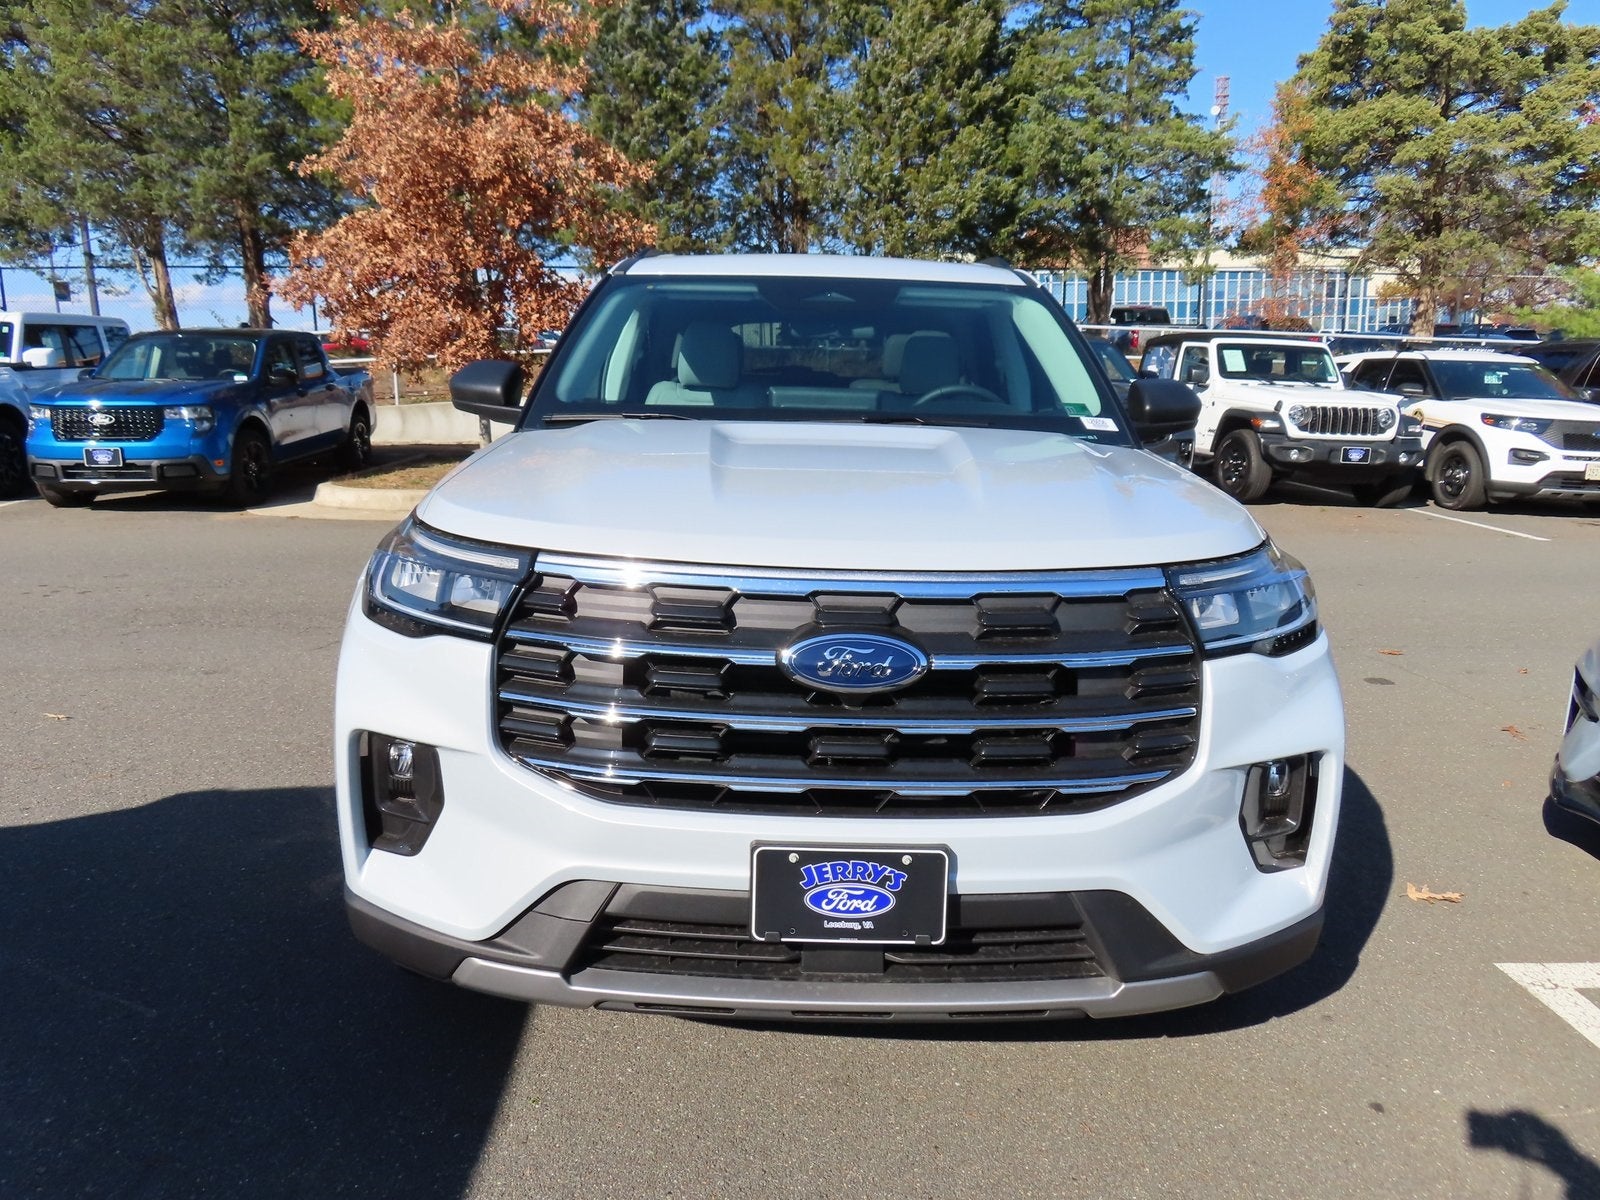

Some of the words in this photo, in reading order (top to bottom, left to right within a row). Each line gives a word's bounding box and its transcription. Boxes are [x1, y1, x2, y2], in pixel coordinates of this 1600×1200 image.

[817, 645, 893, 677] Ford
[800, 860, 908, 891] JERRY'S
[821, 889, 878, 911] Ford
[862, 920, 875, 930] VA
